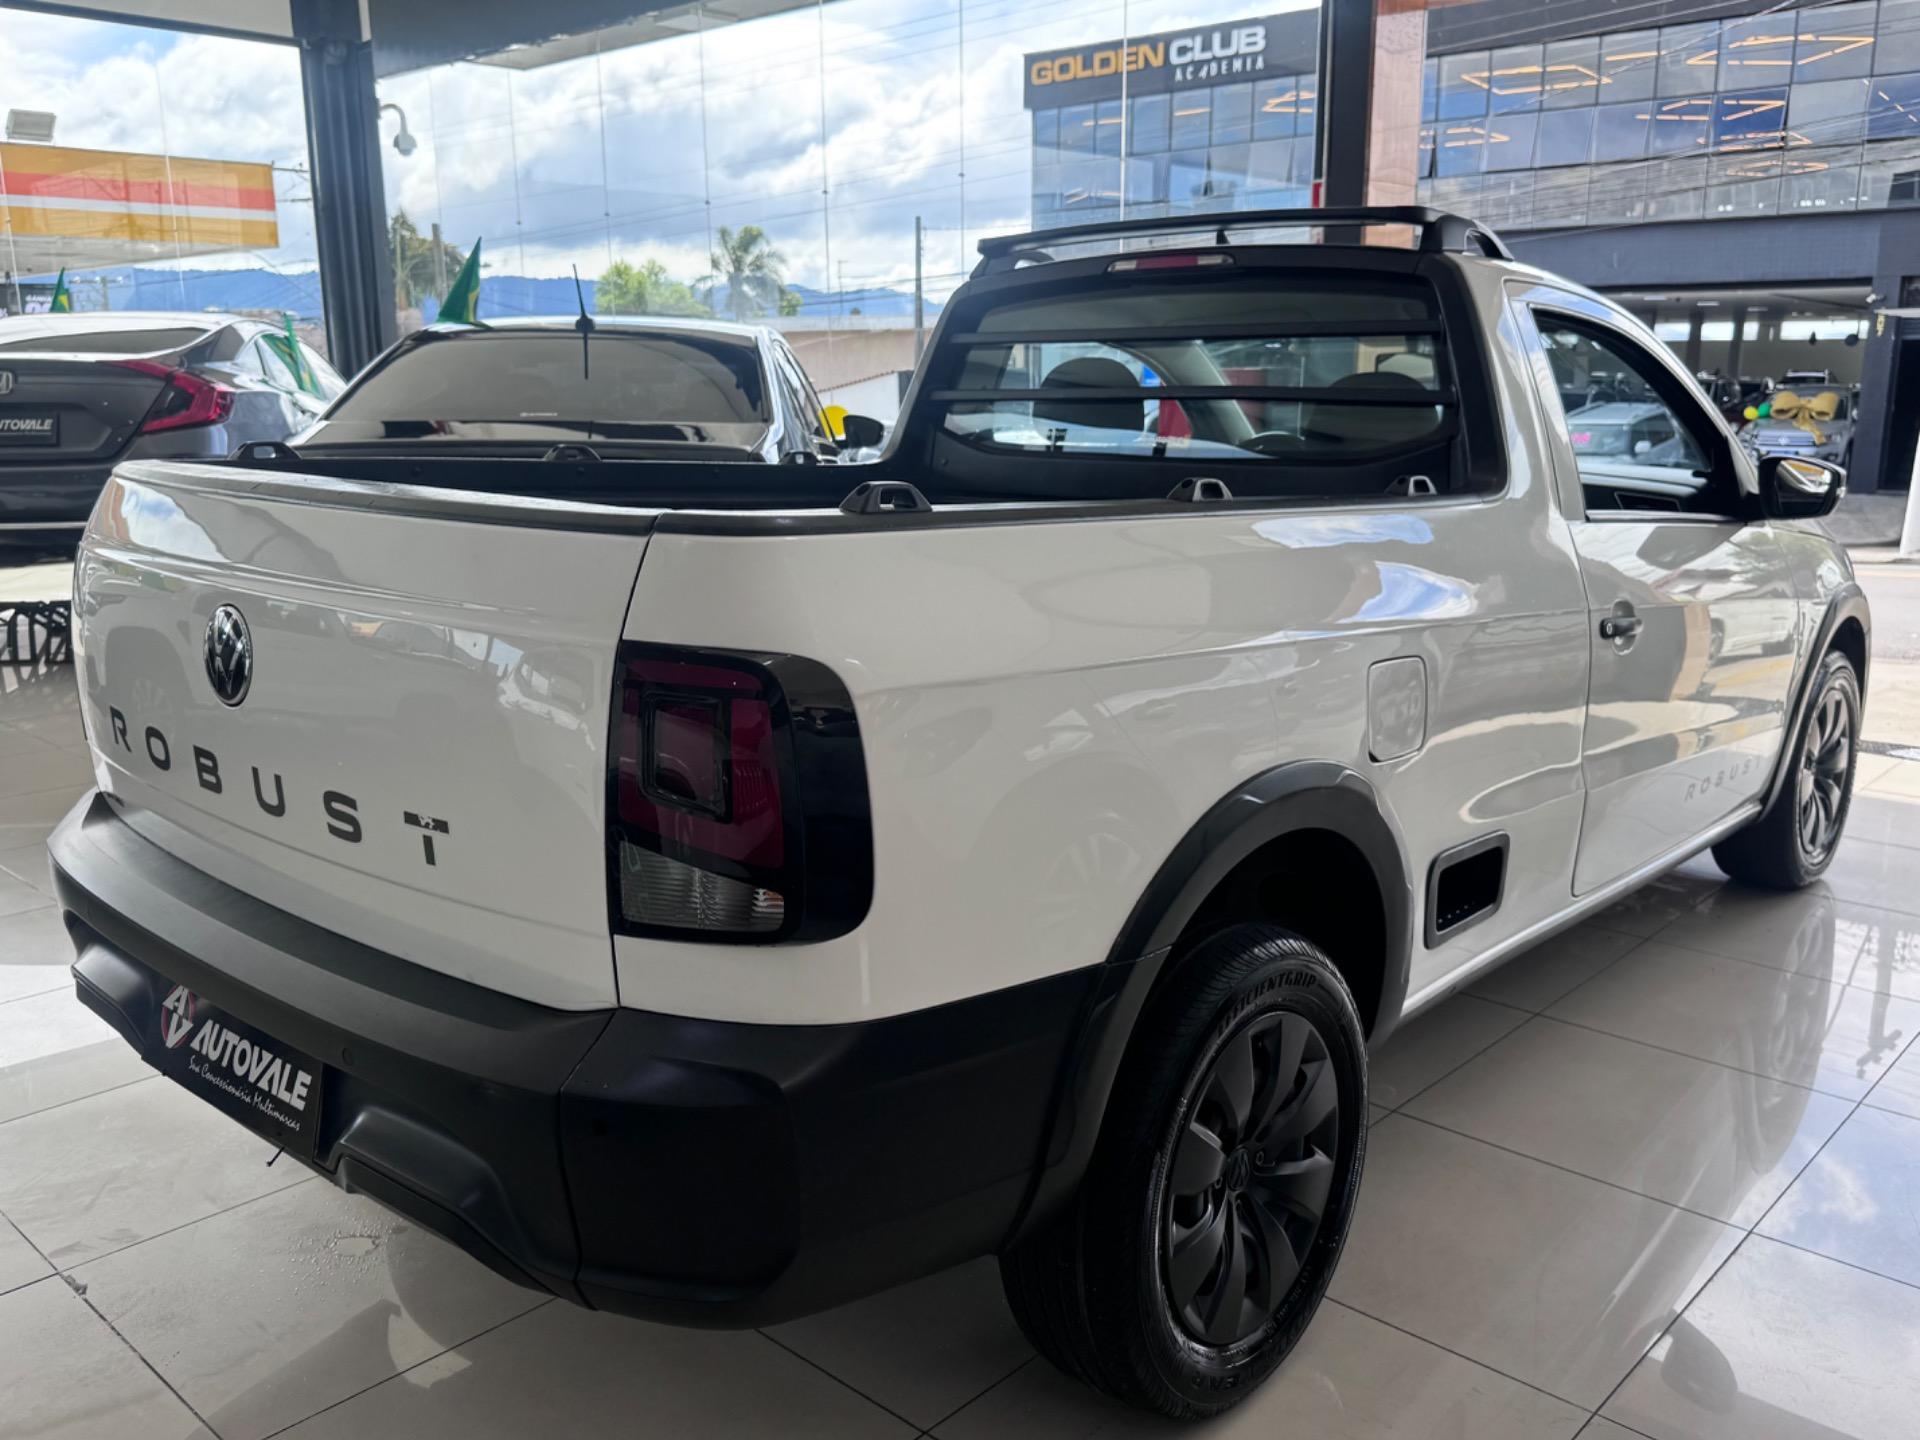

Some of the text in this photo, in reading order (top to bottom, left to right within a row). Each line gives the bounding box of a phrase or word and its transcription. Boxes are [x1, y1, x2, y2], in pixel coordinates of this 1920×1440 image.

[1031, 25, 1266, 86] GOLDEN CLUB
[1174, 54, 1266, 82] ACADEMIA
[109, 705, 450, 866] ROBUST
[190, 1018, 313, 1111] AUTOVALE
